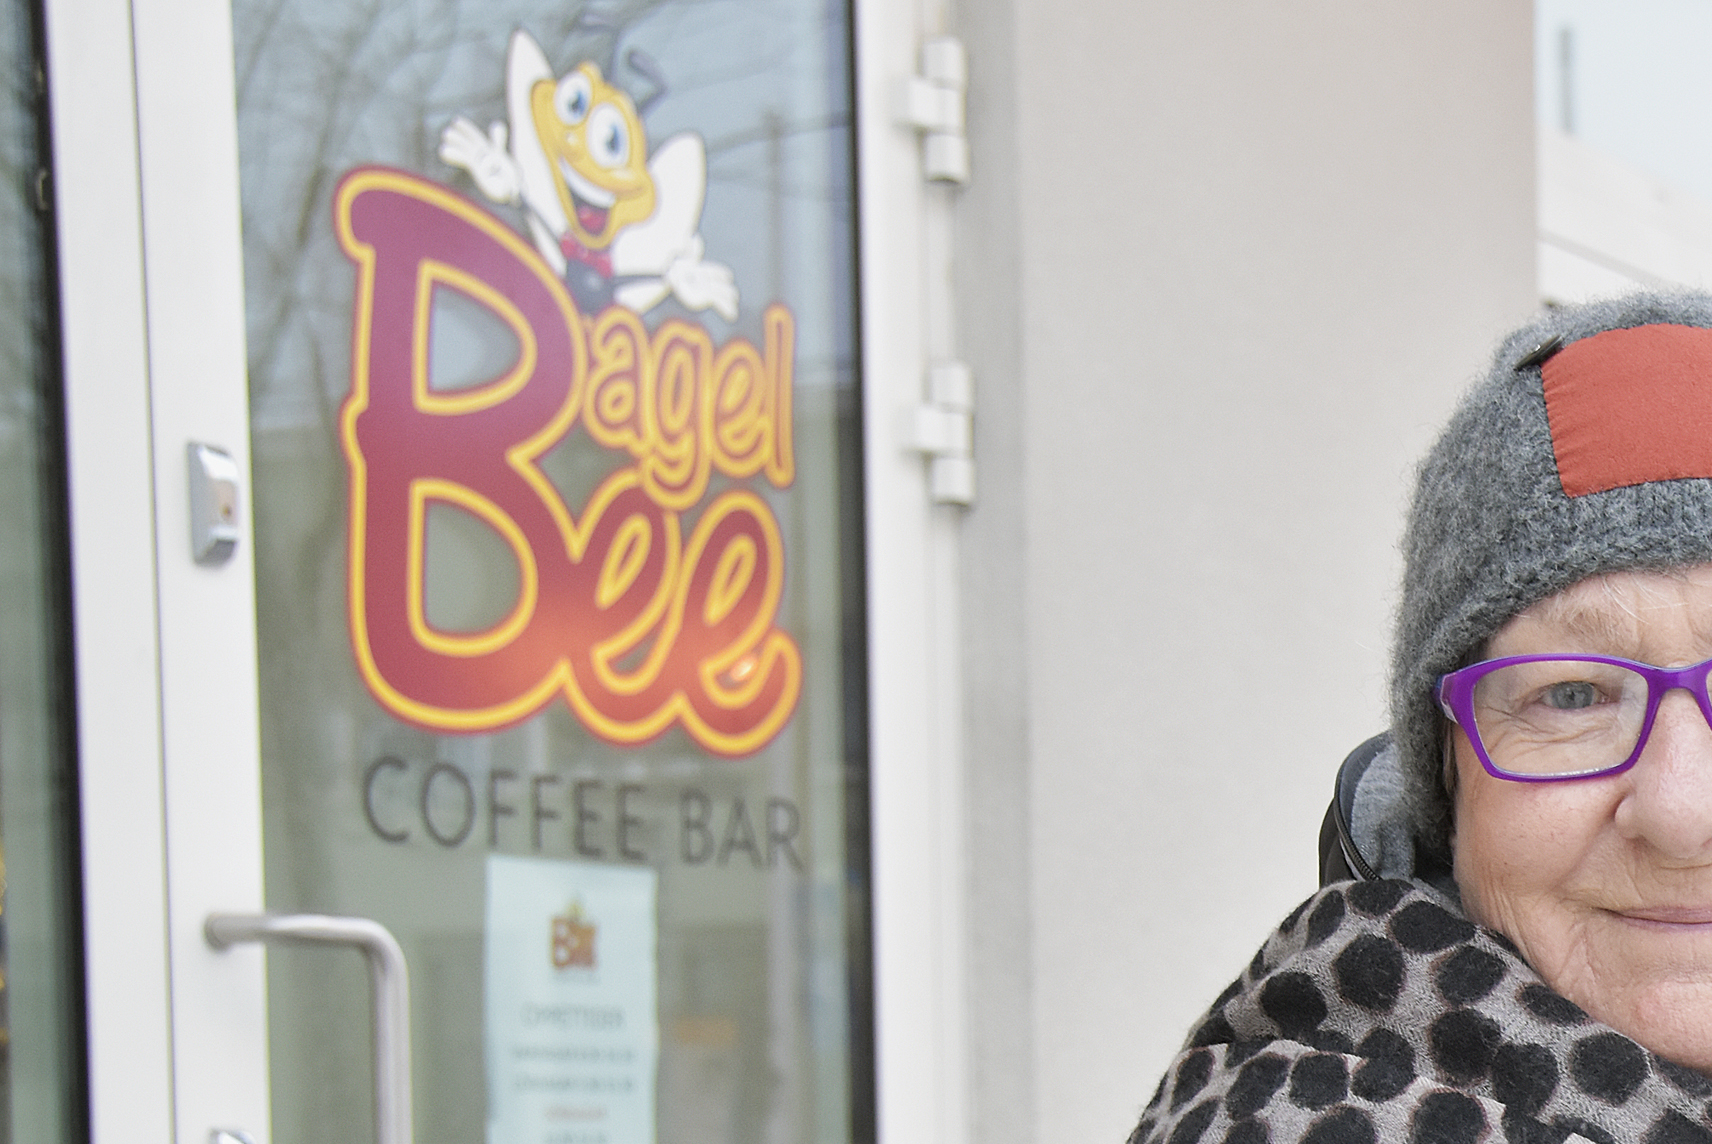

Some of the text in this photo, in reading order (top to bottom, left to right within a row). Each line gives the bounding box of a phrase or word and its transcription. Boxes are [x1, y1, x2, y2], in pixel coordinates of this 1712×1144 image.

[334, 164, 802, 758] Bee
[362, 754, 807, 874] COFFEE BAR
